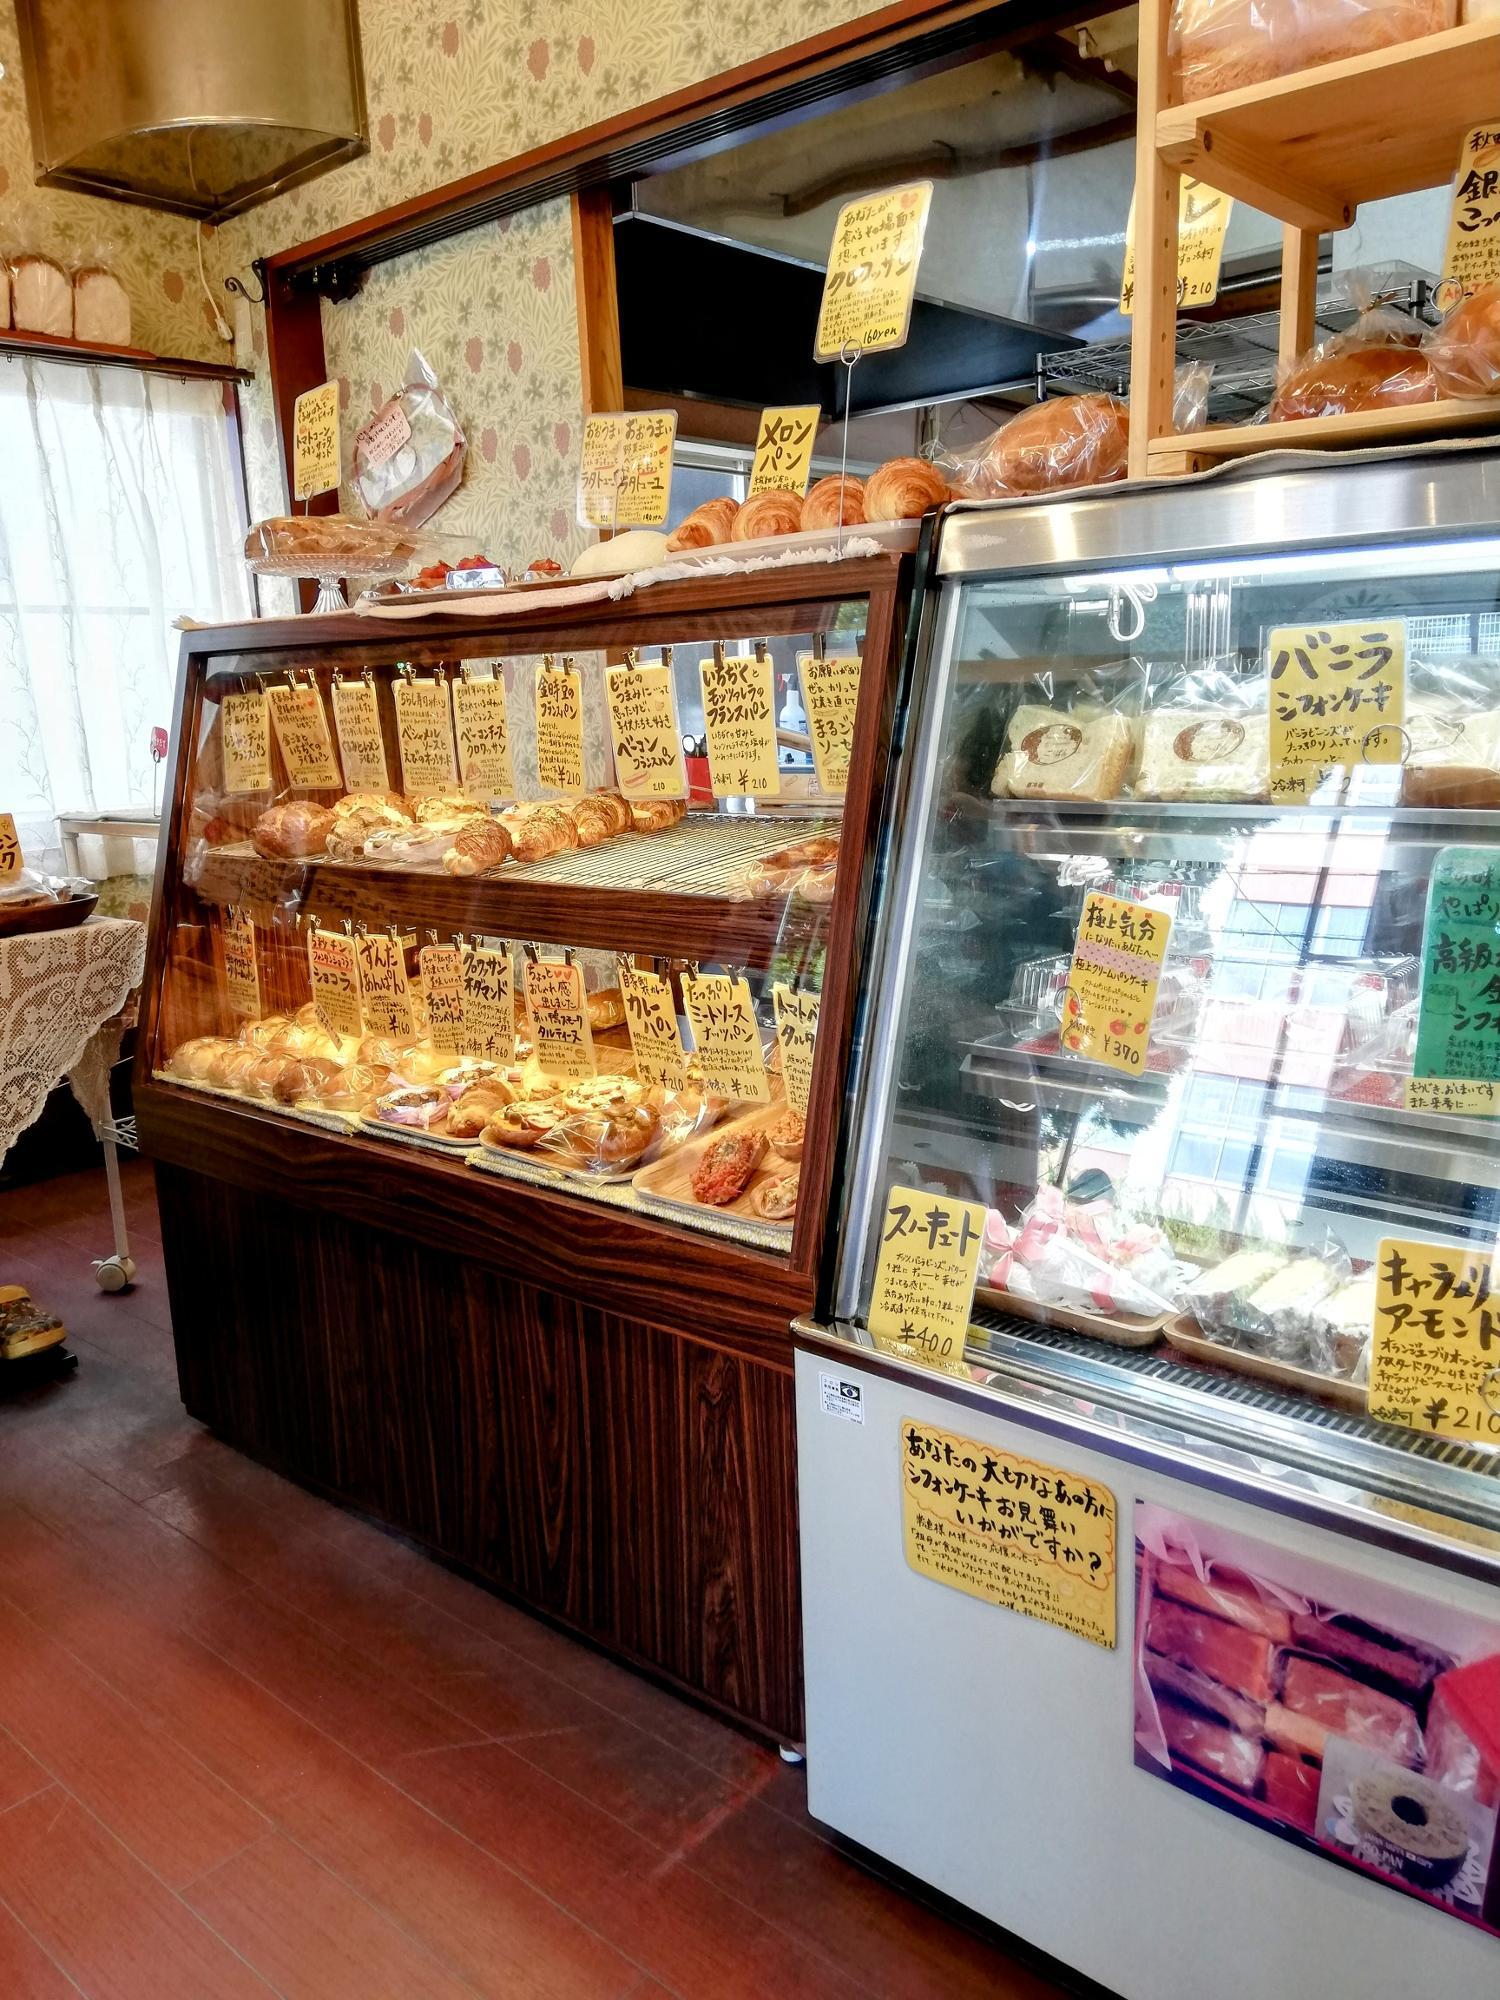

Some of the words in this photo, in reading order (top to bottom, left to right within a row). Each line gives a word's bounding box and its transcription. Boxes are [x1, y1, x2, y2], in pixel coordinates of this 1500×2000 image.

[757, 416, 812, 449] メロン
[759, 446, 802, 472] パン
[1271, 631, 1393, 680] バニラ
[538, 674, 575, 703] 金時豆の
[610, 674, 643, 692] ビールの
[708, 683, 764, 706] モッツァレラの
[540, 701, 578, 720] フランスパン
[1275, 681, 1393, 721] シフォンケーキ
[616, 714, 672, 734] 子供たちも好き
[706, 701, 770, 728] フランスパン
[466, 743, 506, 759] クロワッサン
[617, 735, 659, 758] ベーコン
[633, 747, 677, 770] フランスパン
[557, 764, 581, 789] ¥210
[652, 781, 666, 791] 210
[738, 769, 768, 792] ¥210
[1086, 902, 1157, 941] 極上気分
[360, 938, 398, 970] ずんだ
[463, 951, 508, 977] クロワッサン
[1431, 932, 1500, 974] 高級
[313, 965, 351, 991] ショコラ
[363, 969, 405, 995] あんぱん
[528, 964, 553, 982] ちょっと
[1074, 956, 1149, 993] 極上クリームパンケーキ
[426, 988, 463, 1012] チョコレート
[528, 981, 572, 997] おしゃれ感
[687, 979, 733, 1002] たっぷり
[541, 996, 577, 1010] 出しました
[626, 993, 660, 1020] カレー
[689, 1003, 750, 1025] ミートソース
[389, 1013, 410, 1038] ¥160
[538, 1025, 582, 1043] タルティーヌ
[644, 1016, 676, 1041] パン
[702, 1024, 754, 1043] ナッツパン
[485, 1035, 509, 1061] ¥260
[1104, 1033, 1140, 1065] ¥370
[659, 1068, 684, 1092] ¥210
[731, 1077, 759, 1098] ¥210
[884, 1204, 981, 1257] スノーキュート
[897, 1319, 953, 1356] ¥400
[1378, 1303, 1500, 1350] アーモンド
[906, 1427, 1113, 1520] あなたの大切なあの方に
[907, 1461, 1076, 1536] シフォンケーキお見舞い
[956, 1508, 1102, 1581] いかがですか?
